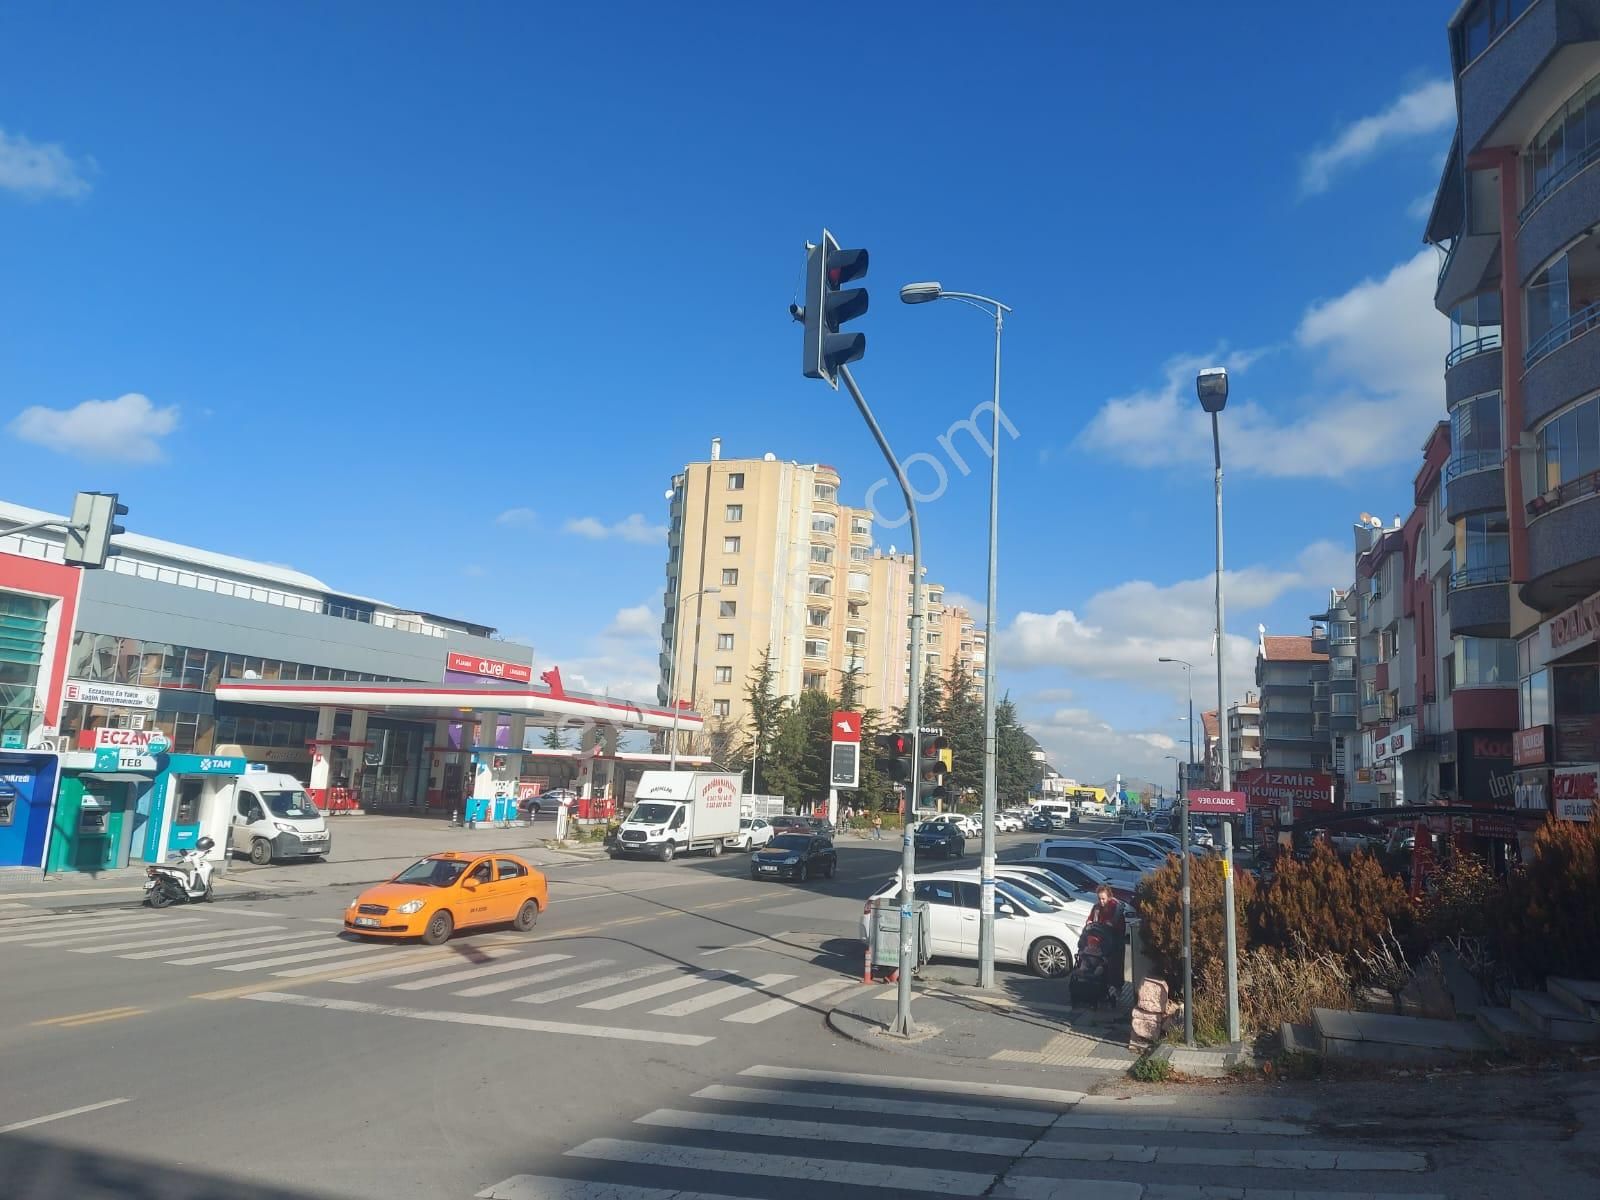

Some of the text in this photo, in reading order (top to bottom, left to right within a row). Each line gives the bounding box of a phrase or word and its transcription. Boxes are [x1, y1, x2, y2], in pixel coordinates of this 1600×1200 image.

[479, 660, 504, 676] durel
[120, 758, 142, 768] TEB
[212, 761, 232, 769] TAM
[1265, 771, 1316, 787] İZMİR
